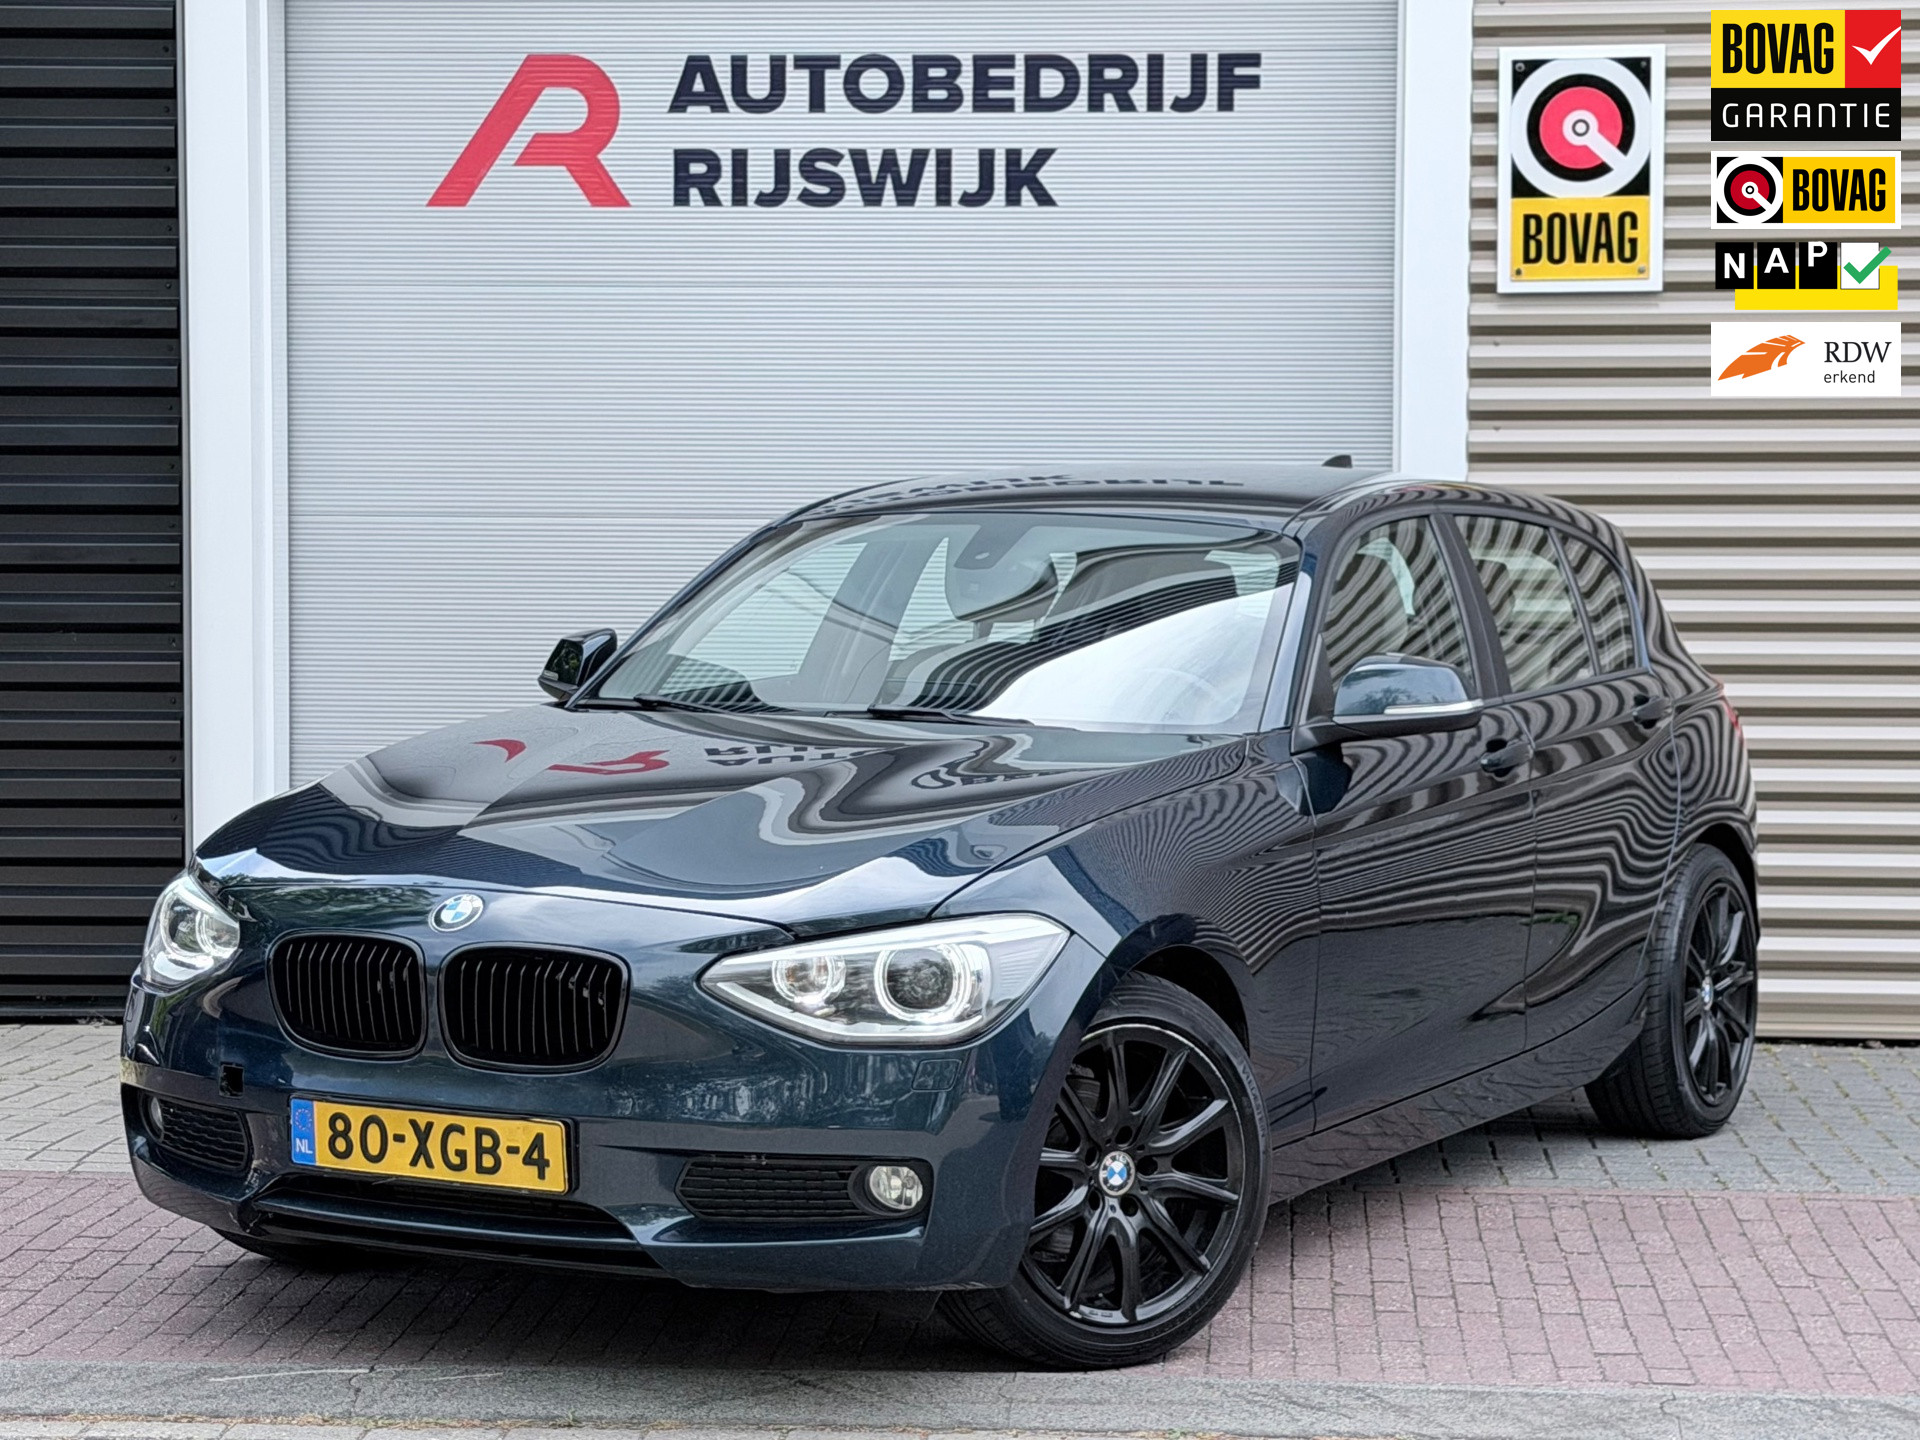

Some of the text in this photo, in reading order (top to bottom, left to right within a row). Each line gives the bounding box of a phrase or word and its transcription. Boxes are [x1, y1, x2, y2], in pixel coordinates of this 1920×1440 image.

[668, 52, 1262, 114] AUTOBEDRIJF
[672, 147, 1058, 208] RIJSWIJK
[1522, 210, 1639, 265] BOVAG
[295, 1138, 313, 1155] NL
[327, 1111, 551, 1181] 80-XGB-4
